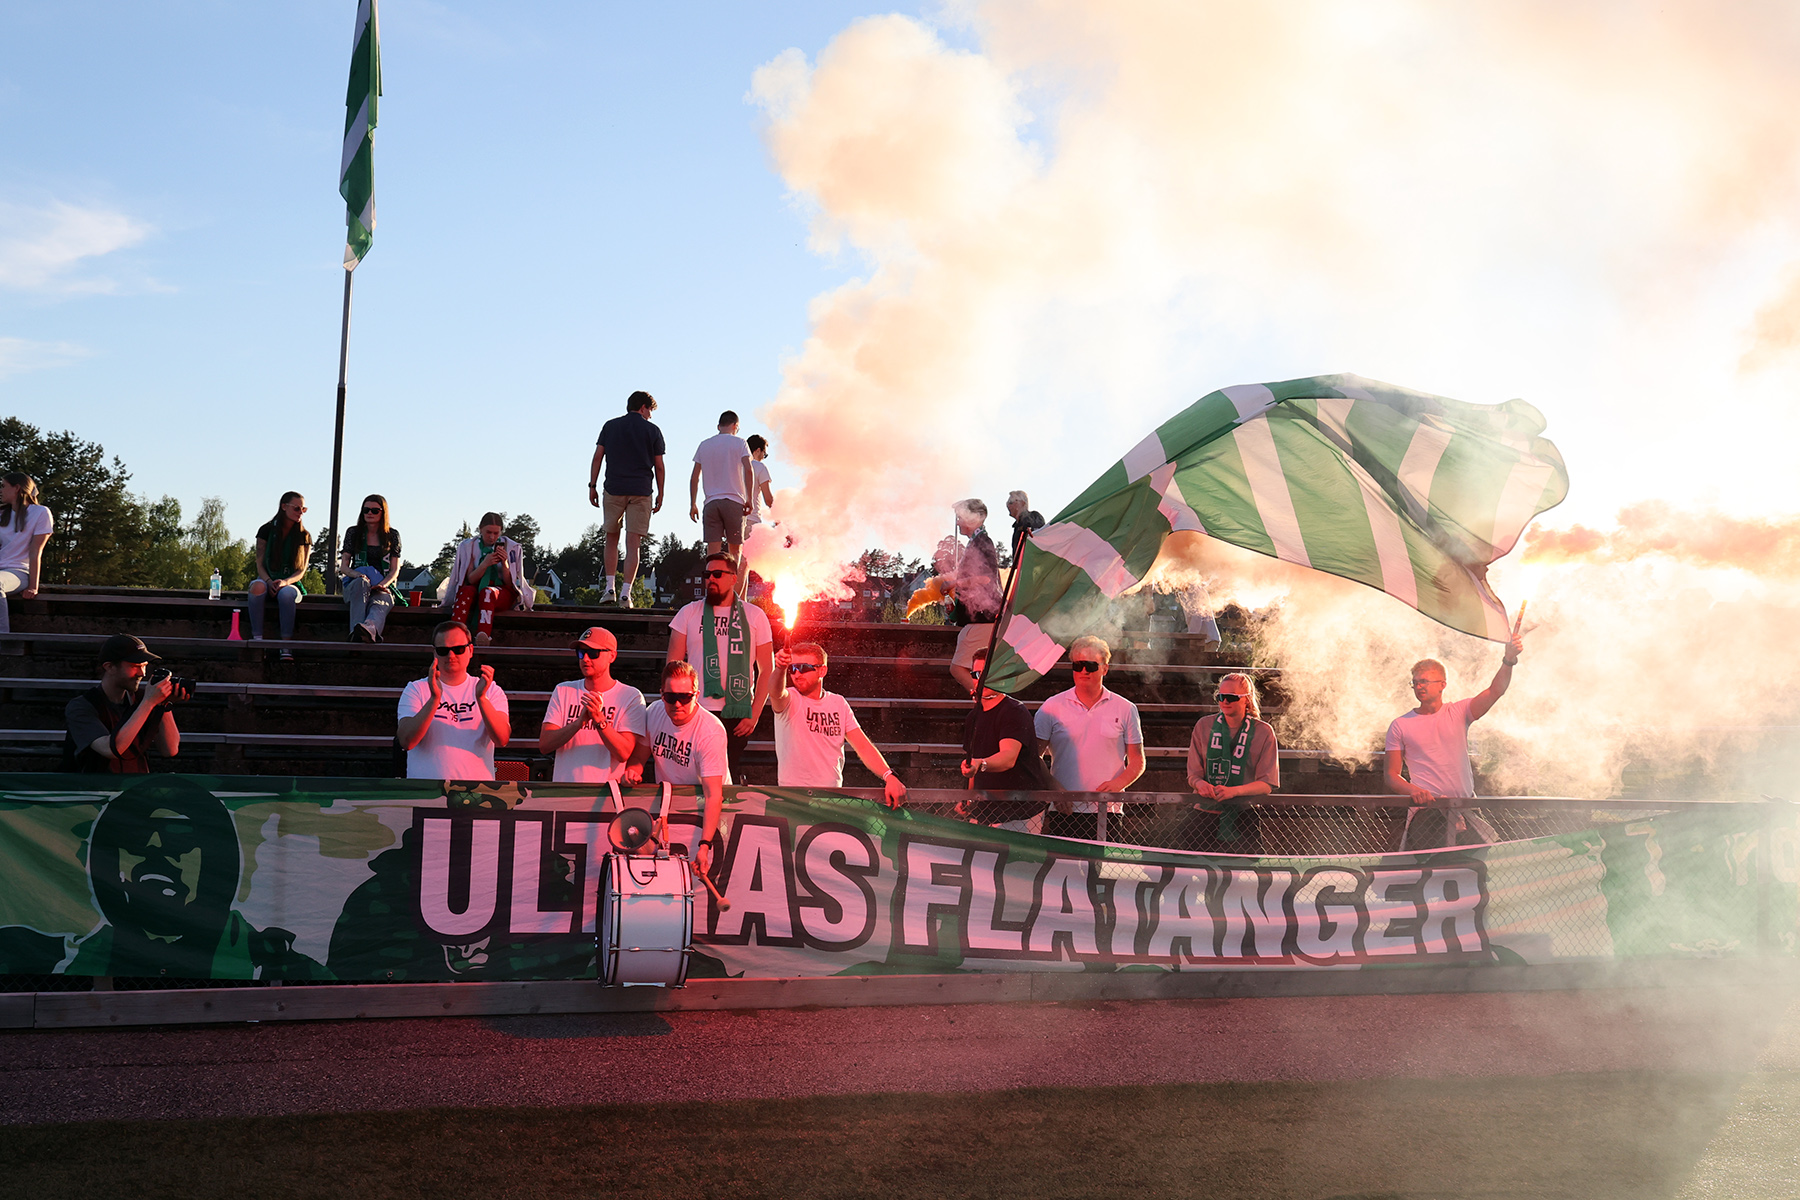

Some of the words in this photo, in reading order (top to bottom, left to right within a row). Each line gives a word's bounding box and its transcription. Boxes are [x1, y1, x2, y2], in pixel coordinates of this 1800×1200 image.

[733, 678, 746, 688] FIL
[654, 731, 692, 757] ULTRAS
[420, 817, 870, 941] ULTAS
[903, 842, 1483, 959] FLATANGER
